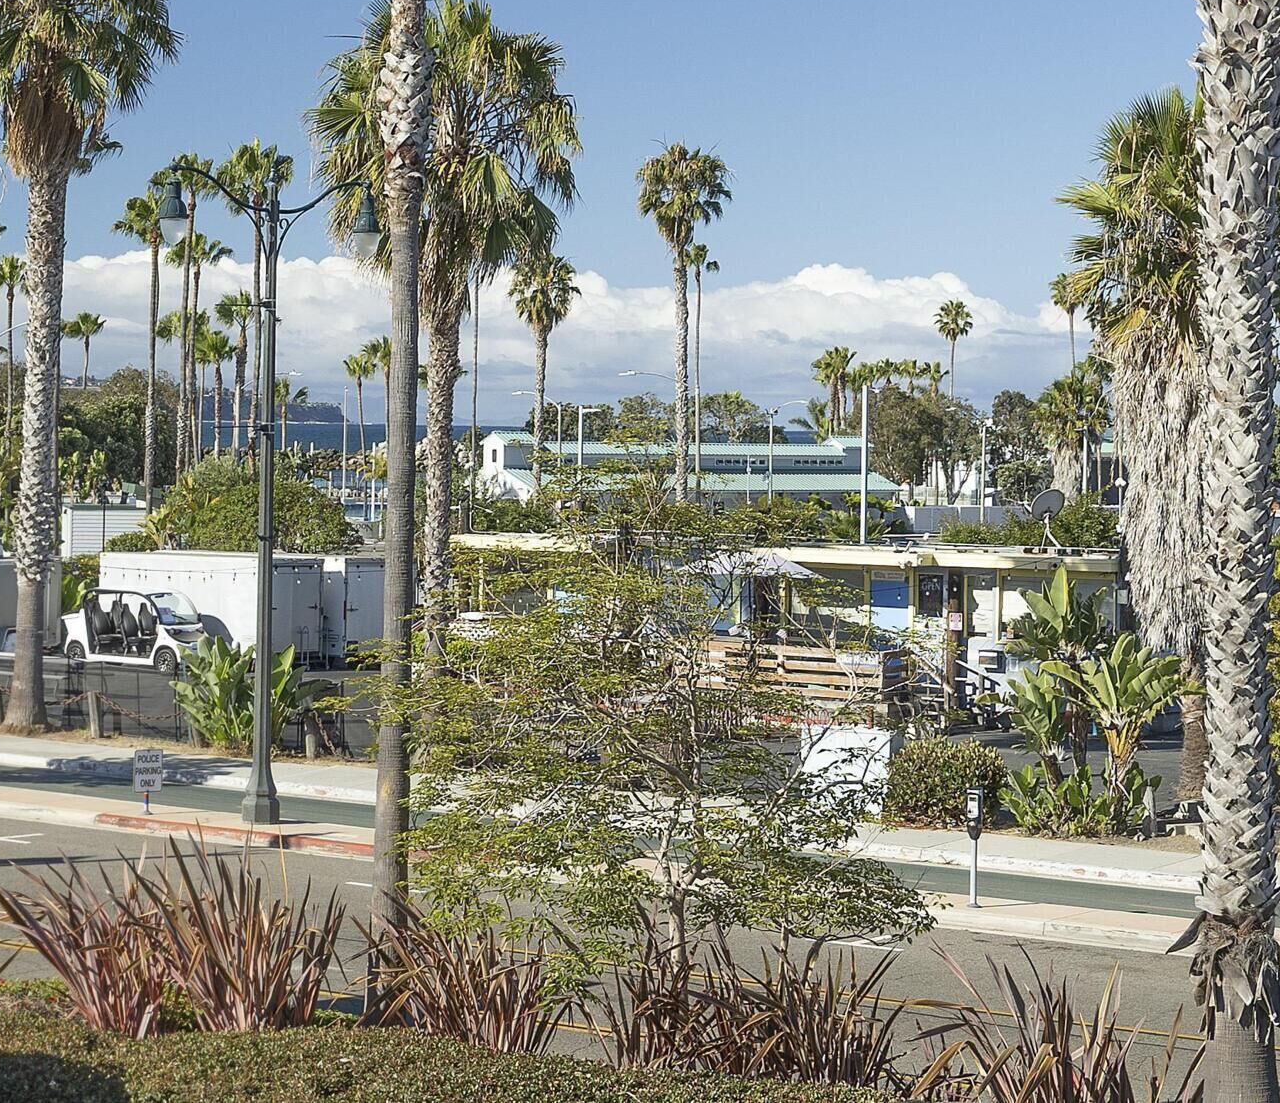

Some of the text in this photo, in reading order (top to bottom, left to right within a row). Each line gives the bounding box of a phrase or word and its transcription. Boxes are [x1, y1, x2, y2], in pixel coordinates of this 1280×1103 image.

[137, 754, 160, 764] POLICE
[135, 766, 162, 776] PARKING
[140, 778, 156, 788] ONLY
